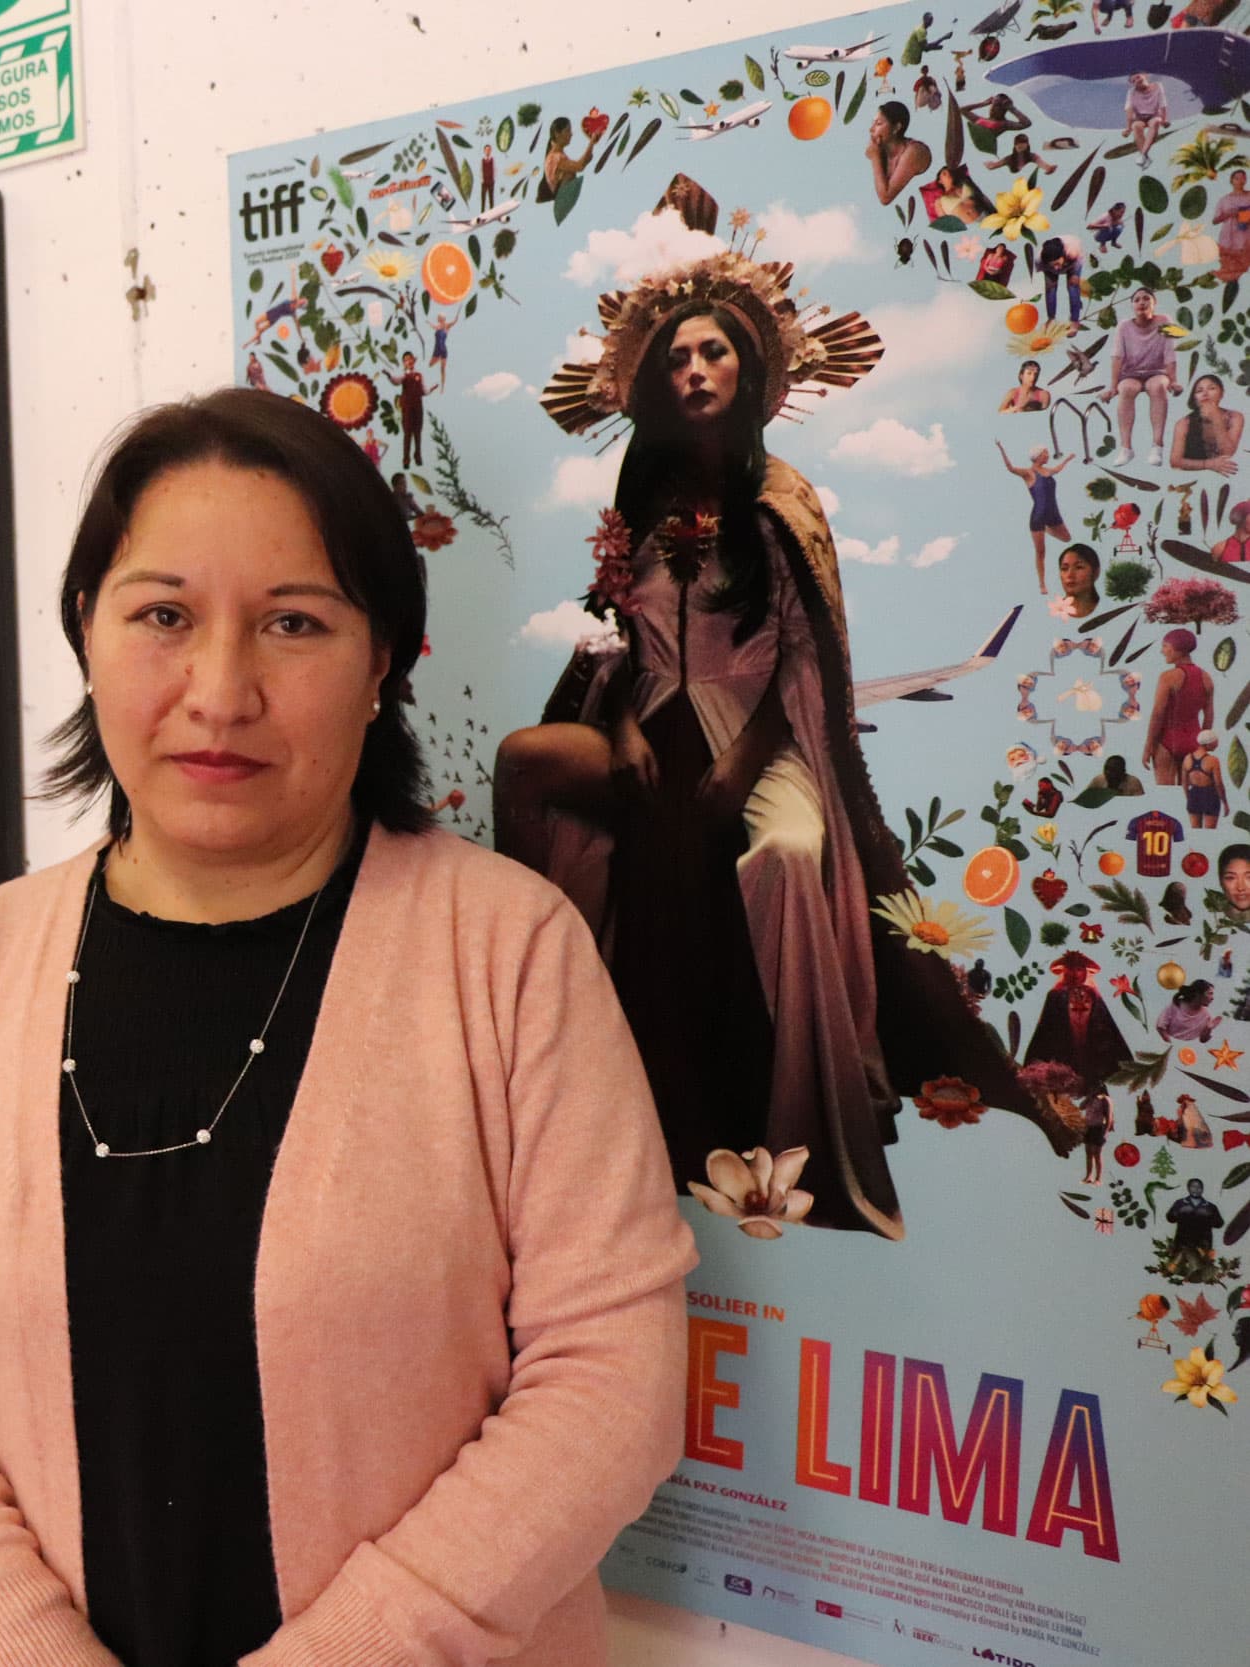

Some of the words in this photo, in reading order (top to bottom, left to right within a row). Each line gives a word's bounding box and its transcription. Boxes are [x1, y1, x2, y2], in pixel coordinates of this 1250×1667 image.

[239, 181, 305, 242] tiff
[1143, 831, 1169, 856] 10
[687, 1290, 758, 1318] SOLIER
[762, 1304, 785, 1322] IN
[684, 1315, 748, 1470] E
[795, 1336, 1120, 1563] LIMA
[693, 1480, 718, 1494] PAZ
[720, 1487, 788, 1513] GONZÁLEZ
